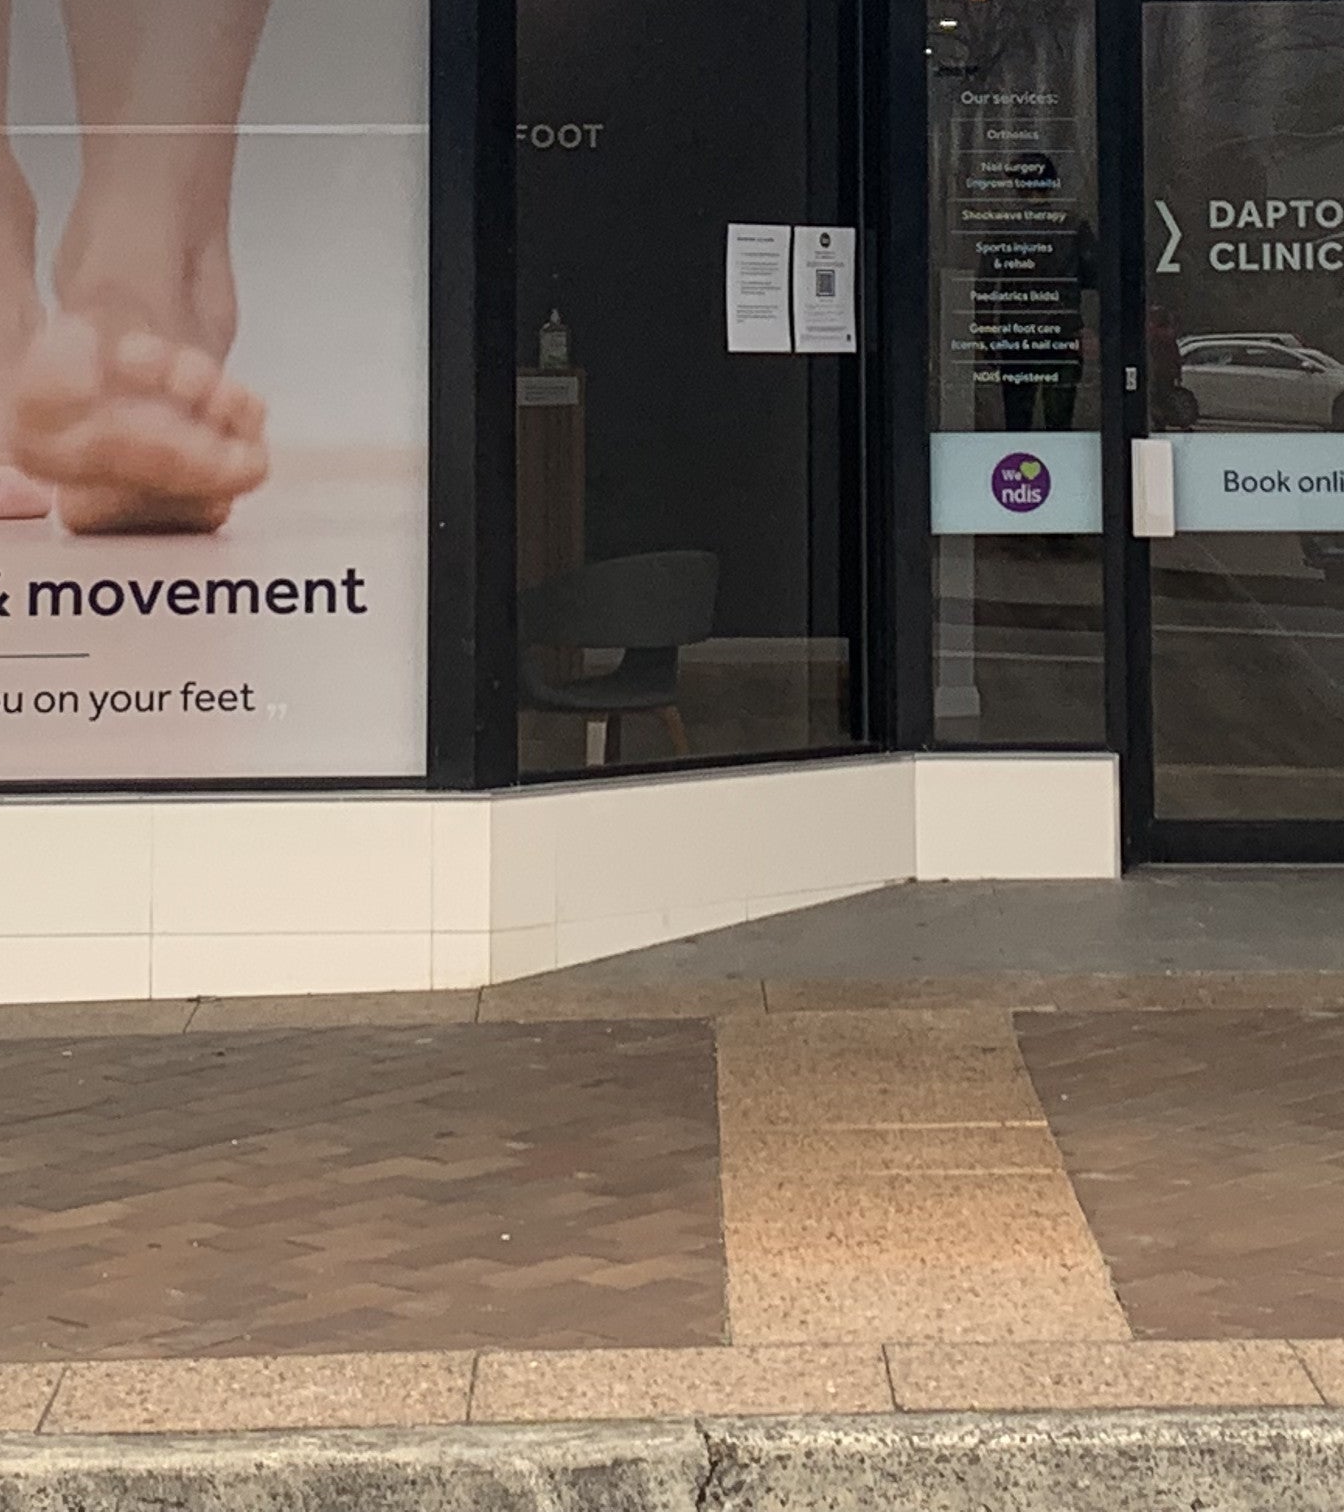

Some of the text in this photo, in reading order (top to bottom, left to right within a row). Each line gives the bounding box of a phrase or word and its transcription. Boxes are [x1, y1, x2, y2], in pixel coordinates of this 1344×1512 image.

[960, 90, 1059, 105] Our services:
[1003, 163, 1047, 175] surgery
[961, 209, 1068, 223] Shockwave therapy
[1209, 199, 1344, 229] DAPTO
[975, 241, 1054, 255] Sports injuries
[1004, 258, 1036, 269] rehab
[1209, 242, 1344, 271] CLINIC
[969, 290, 1028, 301] Paediatrics
[968, 322, 1061, 334] General foot care
[1031, 339, 1052, 350] nail
[972, 370, 1059, 385] NDIS registered
[1001, 469, 1022, 481] We
[1223, 469, 1292, 493] Book
[1001, 483, 1042, 504] ndis
[27, 567, 368, 617] movement
[34, 688, 79, 716] on
[88, 685, 172, 721] your
[180, 682, 256, 713] feet
